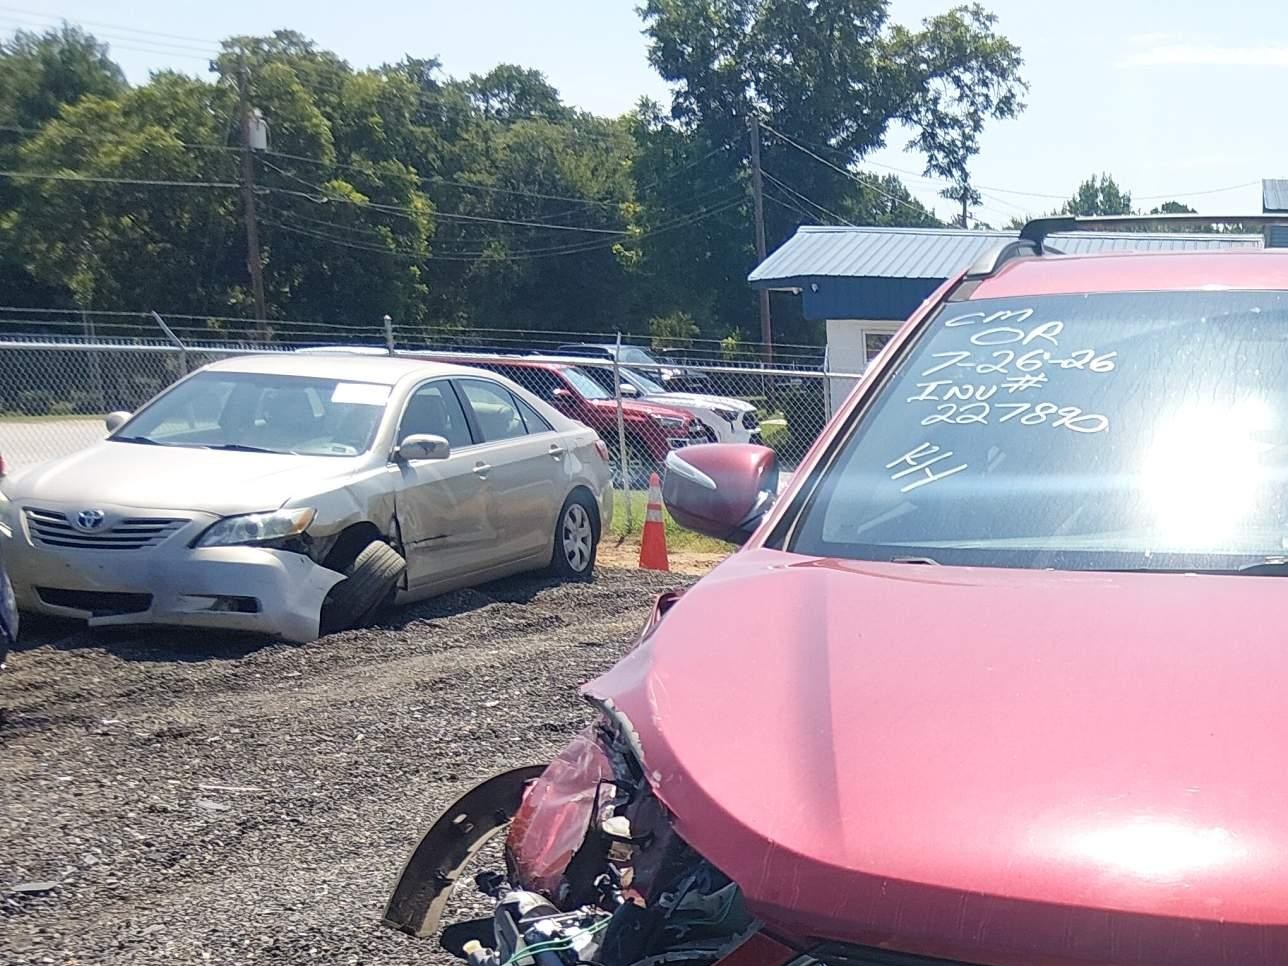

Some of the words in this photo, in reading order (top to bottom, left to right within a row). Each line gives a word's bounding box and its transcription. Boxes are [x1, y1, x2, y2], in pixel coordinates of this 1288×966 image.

[970, 320, 1064, 346] OR
[1001, 372, 1048, 393] #
[920, 401, 1110, 433] 227890
